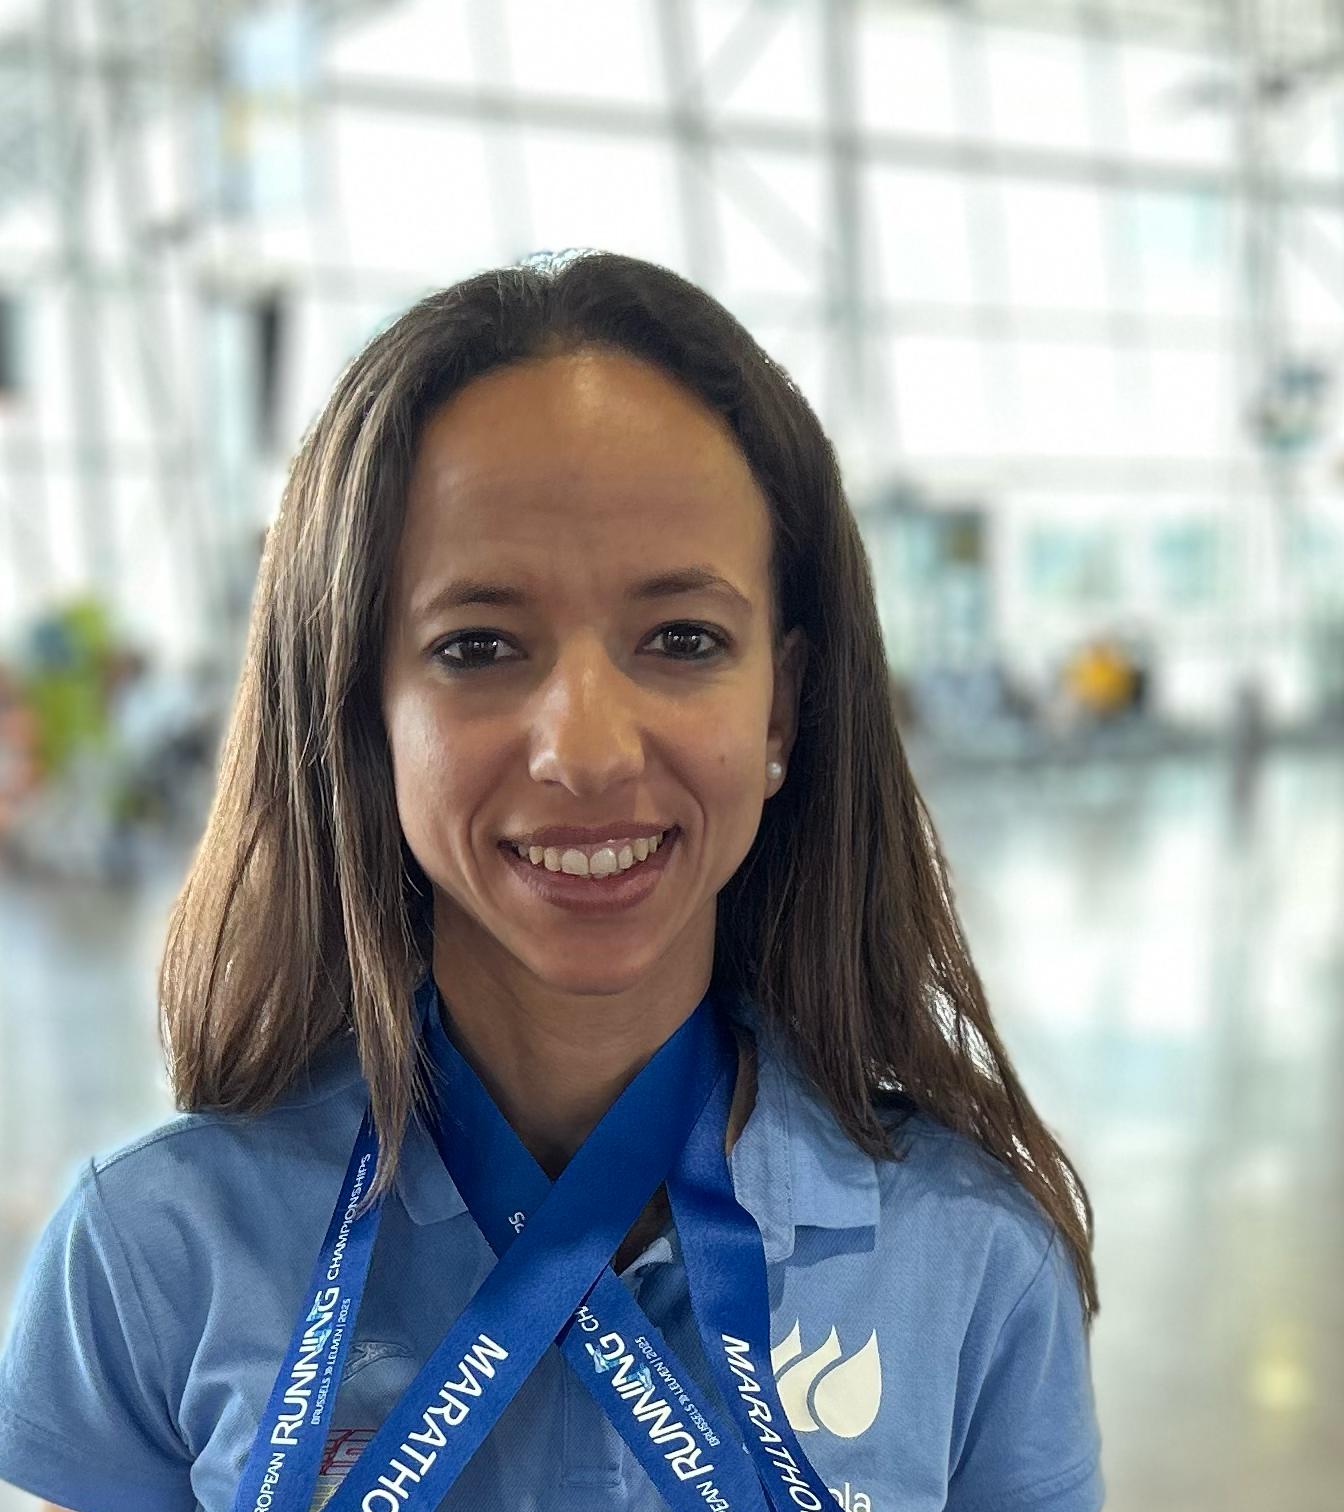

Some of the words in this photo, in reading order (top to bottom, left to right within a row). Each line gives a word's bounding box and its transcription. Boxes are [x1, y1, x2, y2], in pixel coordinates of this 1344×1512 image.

[270, 1286, 340, 1445] RUNNING
[327, 1153, 371, 1281] CHAMPIONSHIPS
[311, 1377, 331, 1425] BRUSSELS
[654, 1362, 683, 1395] LEUVEN
[599, 1331, 714, 1482] RUNNING
[684, 1404, 720, 1446] BRUSSELS
